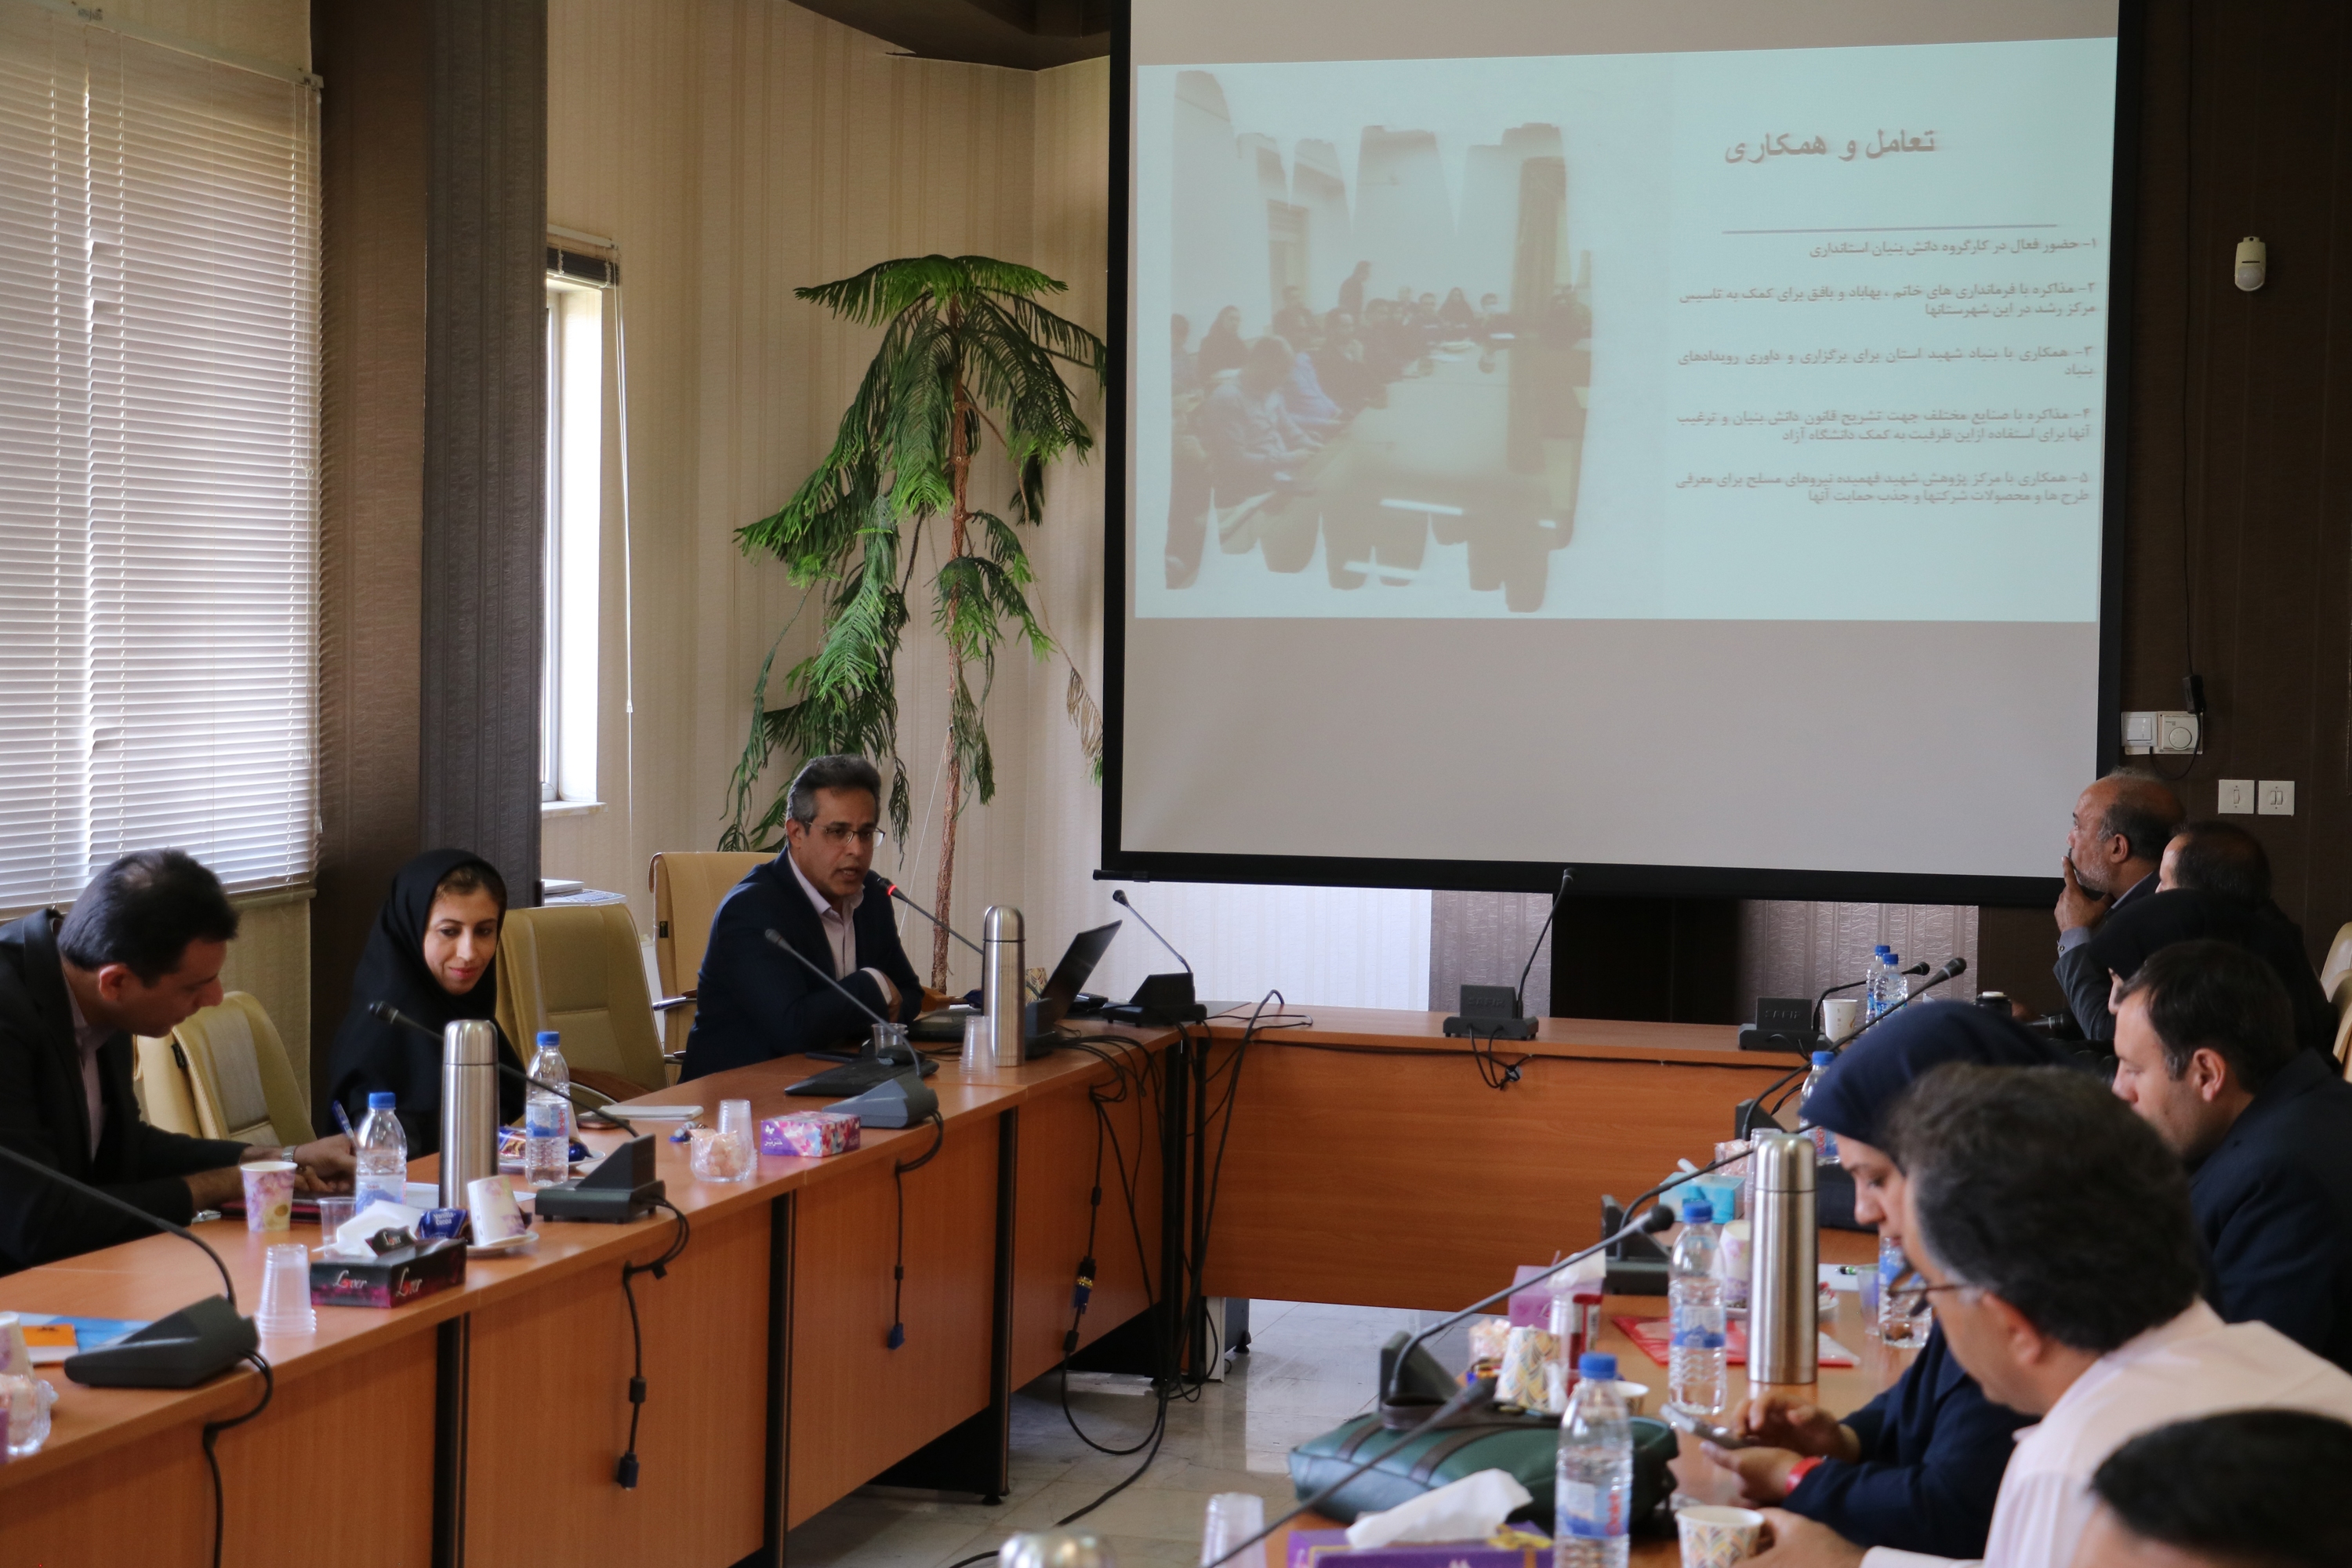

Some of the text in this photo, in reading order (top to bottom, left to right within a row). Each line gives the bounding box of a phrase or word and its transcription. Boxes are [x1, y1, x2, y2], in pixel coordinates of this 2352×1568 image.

[1725, 129, 1934, 163] تعامل و همکاری
[1809, 241, 1867, 257] استانداری
[1871, 241, 1903, 256] بنیان
[1906, 241, 1938, 256] دانش
[1991, 242, 2006, 254] در
[2010, 238, 2038, 253] فعال
[2042, 238, 2078, 253] حضور
[1679, 289, 1724, 303] تاسیس
[1741, 287, 1773, 298] کمک
[1777, 287, 1803, 302] برای
[1807, 285, 1833, 301] بافق
[1838, 291, 1844, 301] و
[1848, 285, 1880, 299] بهاباد
[1893, 285, 1922, 298] خاتم
[1926, 284, 1951, 299] های
[1955, 282, 2015, 299] فرمانداری
[2019, 283, 2027, 294] با
[2032, 281, 2075, 298] مذاکره
[1726, 292, 1737, 303] به
[1925, 301, 2094, 318] مرکز رشد در این شهرستانها
[1678, 350, 1738, 365] رویدادهای
[1745, 350, 1779, 365] داوری
[1787, 354, 1793, 364] و
[1800, 349, 1846, 364] برگزاری
[1853, 348, 1878, 363] برای
[1886, 347, 1921, 363] استان
[1927, 347, 1962, 361] شهید
[1969, 347, 1998, 361] بنیاد
[2004, 346, 2012, 358] با
[2019, 347, 2067, 361] همکاری
[2063, 364, 2092, 378] بنیاد
[1677, 412, 1716, 426] ترغیب
[1721, 416, 1727, 426] و
[1732, 410, 1763, 426] بنیان
[1768, 410, 1798, 425] دانش
[1804, 409, 1836, 425] قانون
[1841, 410, 1882, 426] تشریح
[1887, 412, 1918, 423] جهت
[1923, 409, 1966, 420] مختلف
[1971, 408, 2008, 424] صنایع
[2013, 408, 2022, 419] با
[2027, 408, 2067, 423] مذاکره
[1782, 426, 1804, 443] آزاد
[1808, 429, 1853, 439] دانشگاه
[1858, 429, 1889, 439] کمک
[1893, 432, 1905, 443] به
[1907, 428, 1951, 443] ظرفیت
[1987, 427, 2034, 438] استفاده
[2038, 426, 2064, 442] برای
[2068, 424, 2089, 441] آنها
[1675, 472, 1712, 488] معرفی
[1717, 473, 1742, 487] برای
[1746, 472, 1780, 488] مسلح
[1785, 472, 1832, 487] نیروهای
[1836, 471, 1879, 486] فهمیده
[1883, 472, 1918, 485] شهید
[1921, 473, 1966, 486] پژوهش
[1972, 472, 2000, 486] مرکز
[2005, 471, 2013, 482] با
[2017, 471, 2067, 486] همکاری
[1808, 487, 2089, 505] طرح ها و محصولات شرکتها و جذب حمایت آنها
[332, 1269, 368, 1289] Lover
[395, 1267, 423, 1298] Lover
